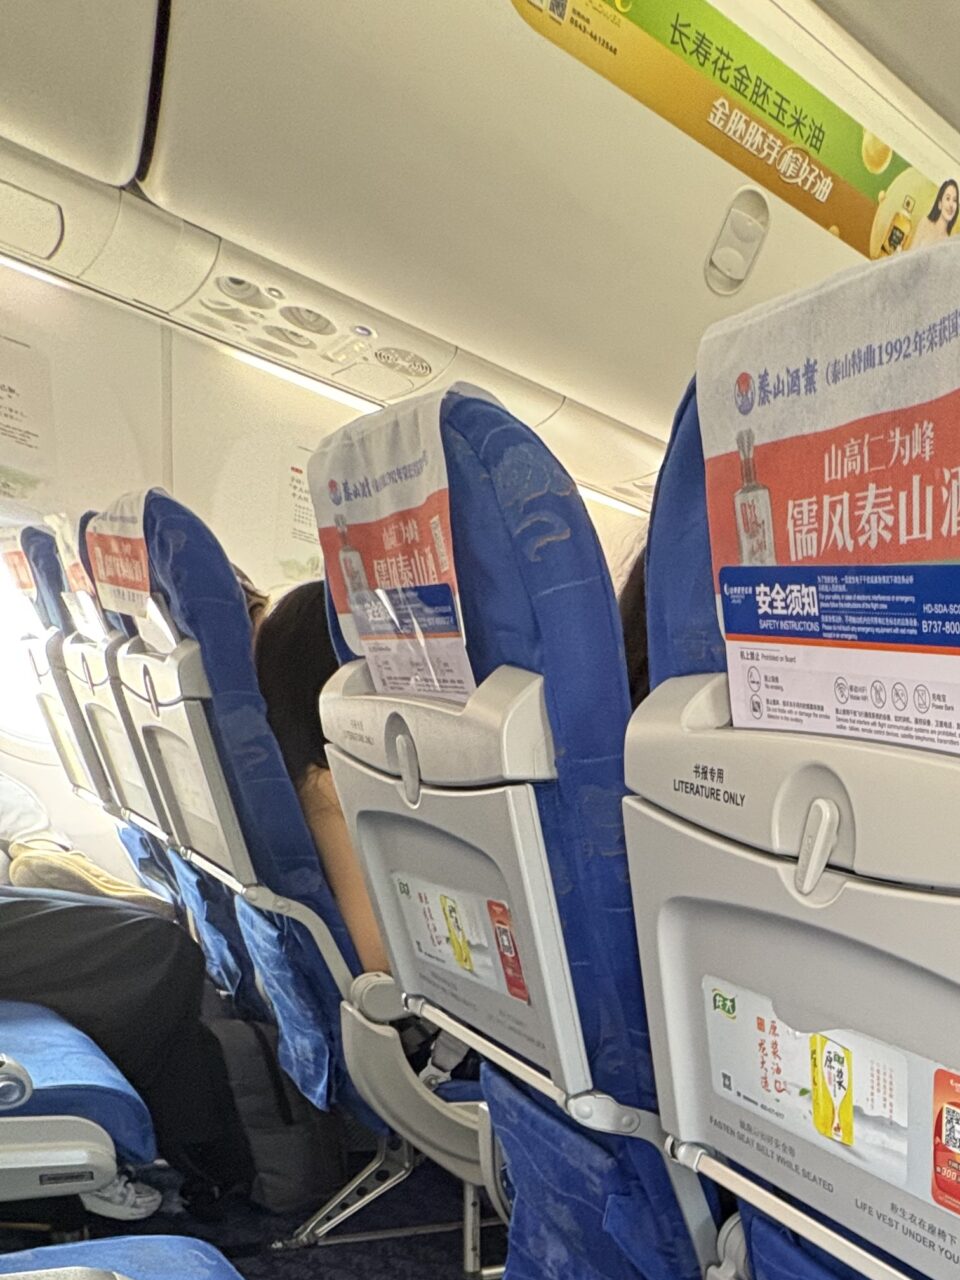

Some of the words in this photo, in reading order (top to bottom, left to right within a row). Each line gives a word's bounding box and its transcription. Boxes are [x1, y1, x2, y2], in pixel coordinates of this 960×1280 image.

[670, 12, 826, 153] 长寿花金胚玉米油
[823, 420, 935, 484] 山高仁为峰
[755, 582, 820, 616] 安全须知
[759, 619, 780, 630] SAFETY
[780, 620, 820, 631] INSTRUCTIONS
[673, 779, 721, 801] LITERATURE
[723, 790, 745, 807] ONLY
[693, 764, 724, 783] 书报专用
[709, 1115, 736, 1137] FASTEN
[736, 1131, 754, 1148] SEAT
[756, 1142, 775, 1159] BELT
[776, 1153, 801, 1175] WHILE
[801, 1167, 834, 1193] SEATED
[855, 1198, 873, 1216] LIFE
[876, 1210, 900, 1230] VEST
[901, 1224, 936, 1251] UNDER
